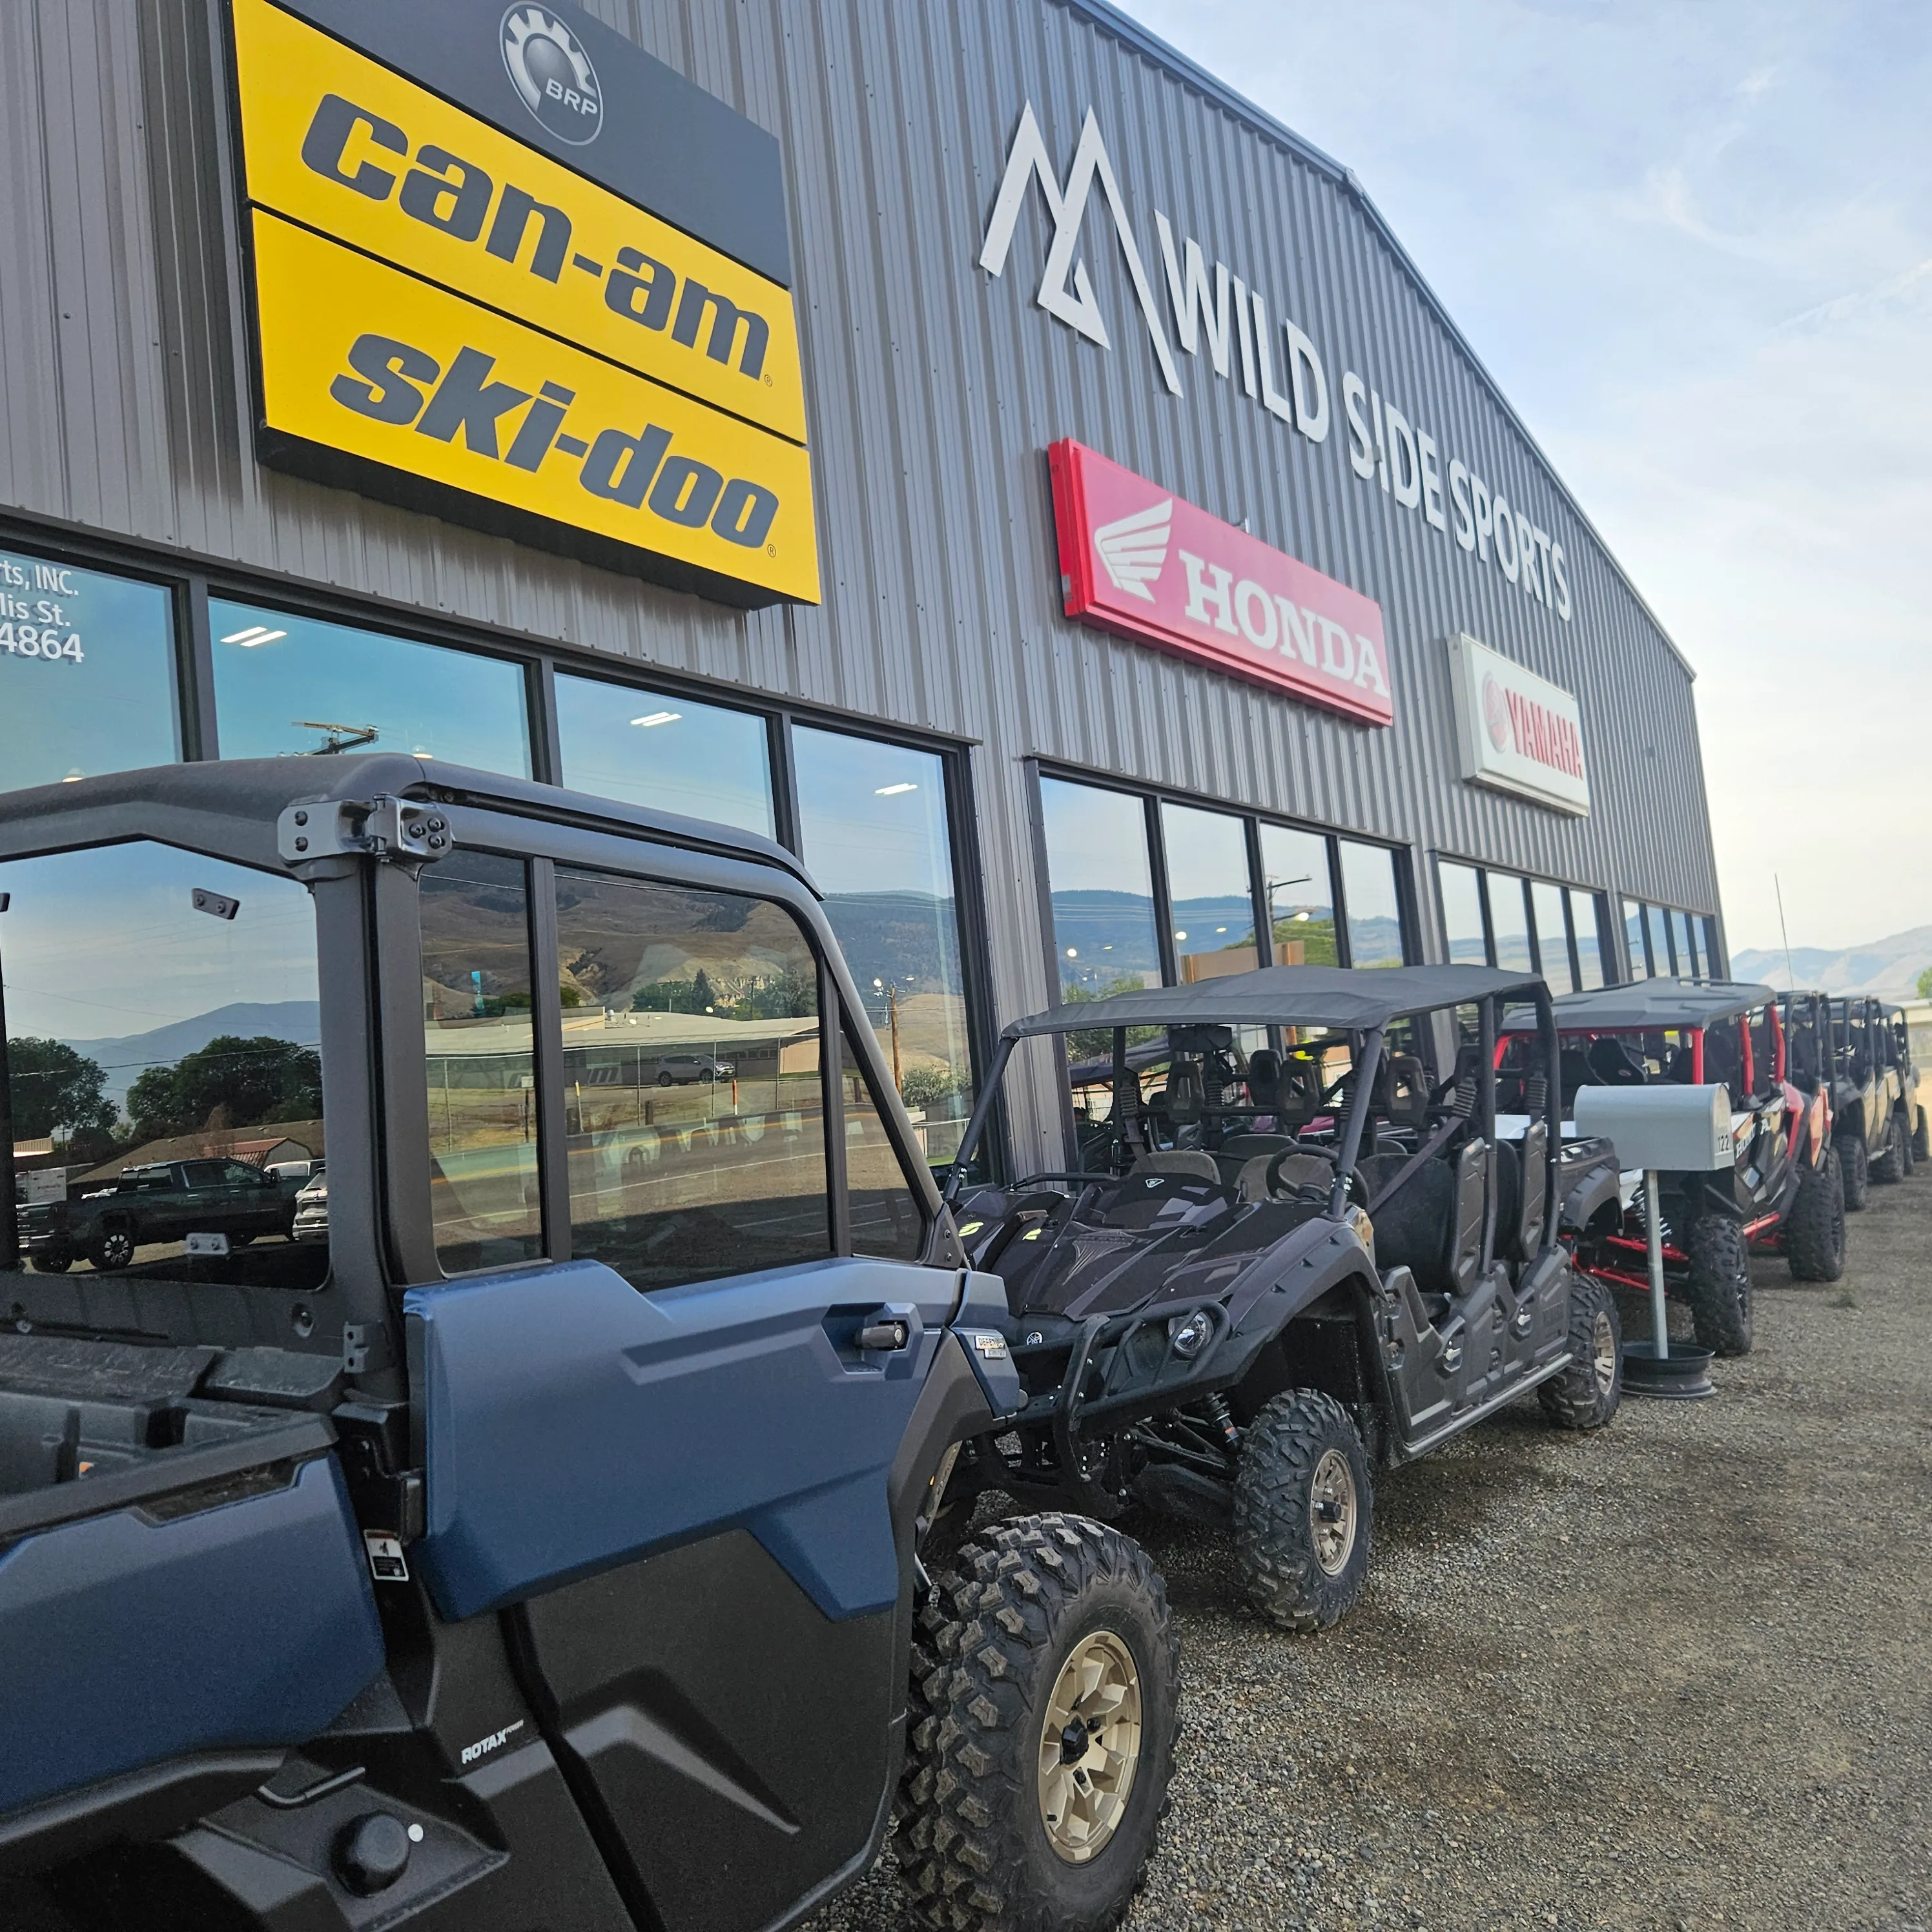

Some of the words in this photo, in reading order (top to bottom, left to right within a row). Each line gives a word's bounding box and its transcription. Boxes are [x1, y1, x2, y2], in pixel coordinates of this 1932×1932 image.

[546, 77, 598, 115] BRP
[302, 94, 769, 381] can-am
[1155, 208, 1329, 442] WILD
[1342, 371, 1445, 532] SIDE
[1450, 459, 1570, 621] SPORTS
[330, 333, 779, 549] ski-doo
[36, 564, 79, 595] INC.
[37, 600, 71, 627] St.
[1178, 549, 1389, 698] HONDA
[0, 622, 85, 663] 4864
[1505, 688, 1583, 781] YAMAHA
[1718, 1135, 1729, 1152] 122
[461, 1728, 506, 1764] ROTAX
